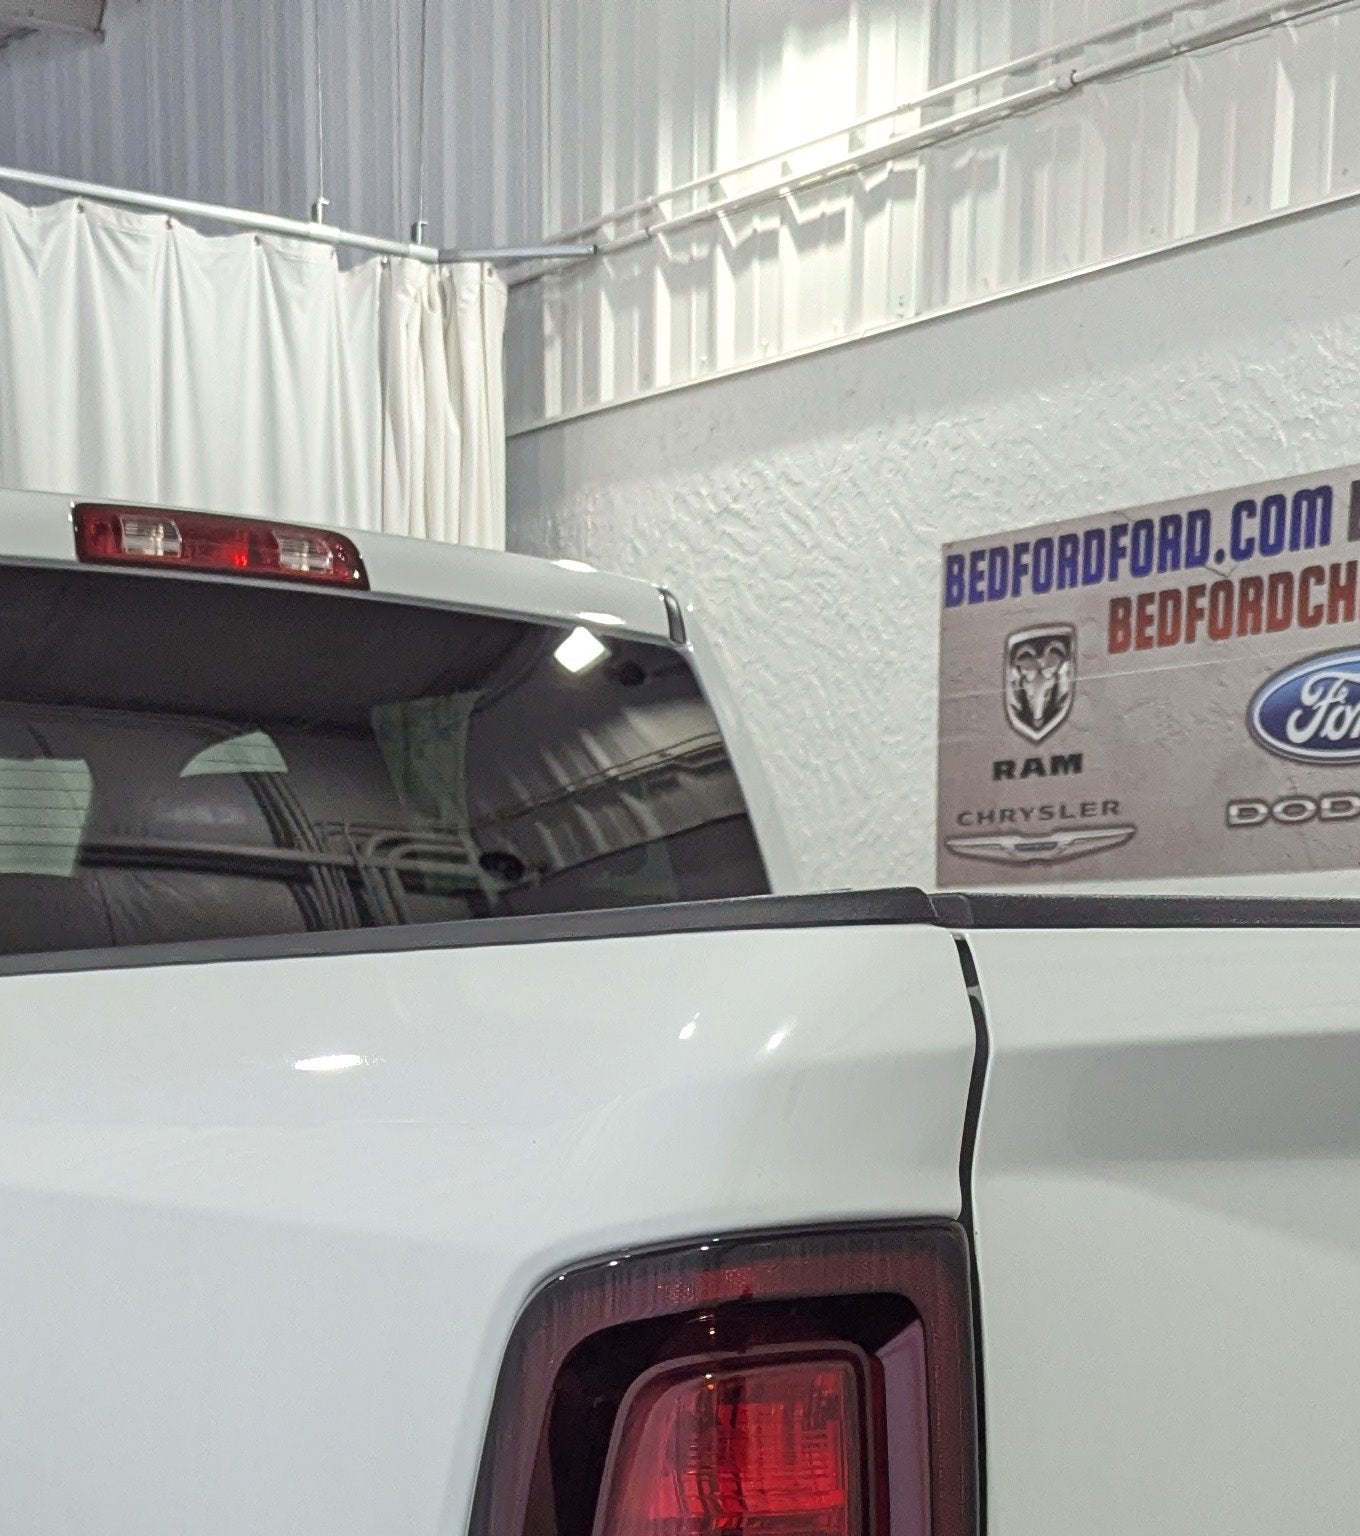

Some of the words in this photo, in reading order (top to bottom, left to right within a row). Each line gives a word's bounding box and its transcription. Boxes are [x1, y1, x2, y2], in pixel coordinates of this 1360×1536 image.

[944, 485, 1333, 609] BEDFORDFORD.COM
[992, 752, 1084, 782] RAM
[957, 799, 1121, 826] CHRYSLER
